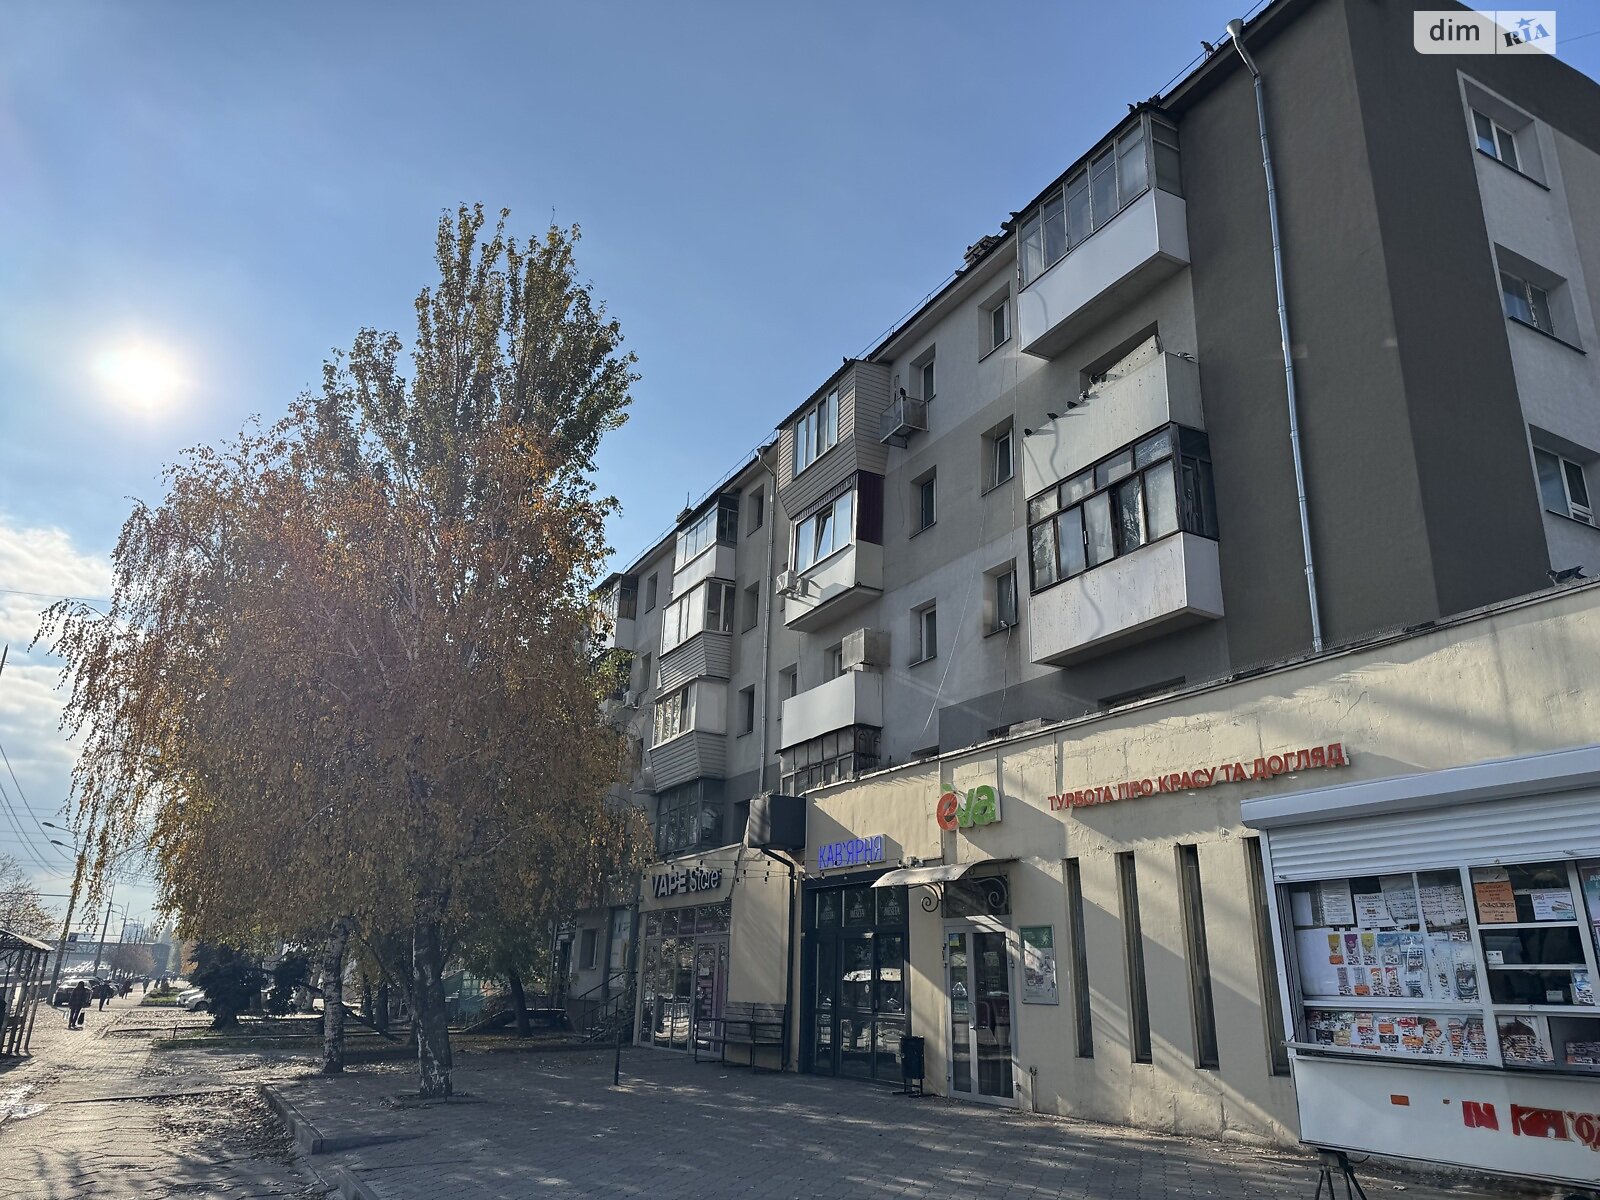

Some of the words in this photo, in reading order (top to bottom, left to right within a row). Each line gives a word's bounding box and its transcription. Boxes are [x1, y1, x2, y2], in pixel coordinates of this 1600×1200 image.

[1047, 785, 1114, 811] ТУРБОТА
[1117, 778, 1154, 800] ПРО
[1158, 766, 1217, 793] КРАСУ
[1220, 762, 1248, 783] ТА
[1252, 742, 1345, 780] ДОГЛЯД
[936, 784, 1002, 832] eva
[652, 870, 688, 898] VAPE
[689, 867, 720, 892] Store
